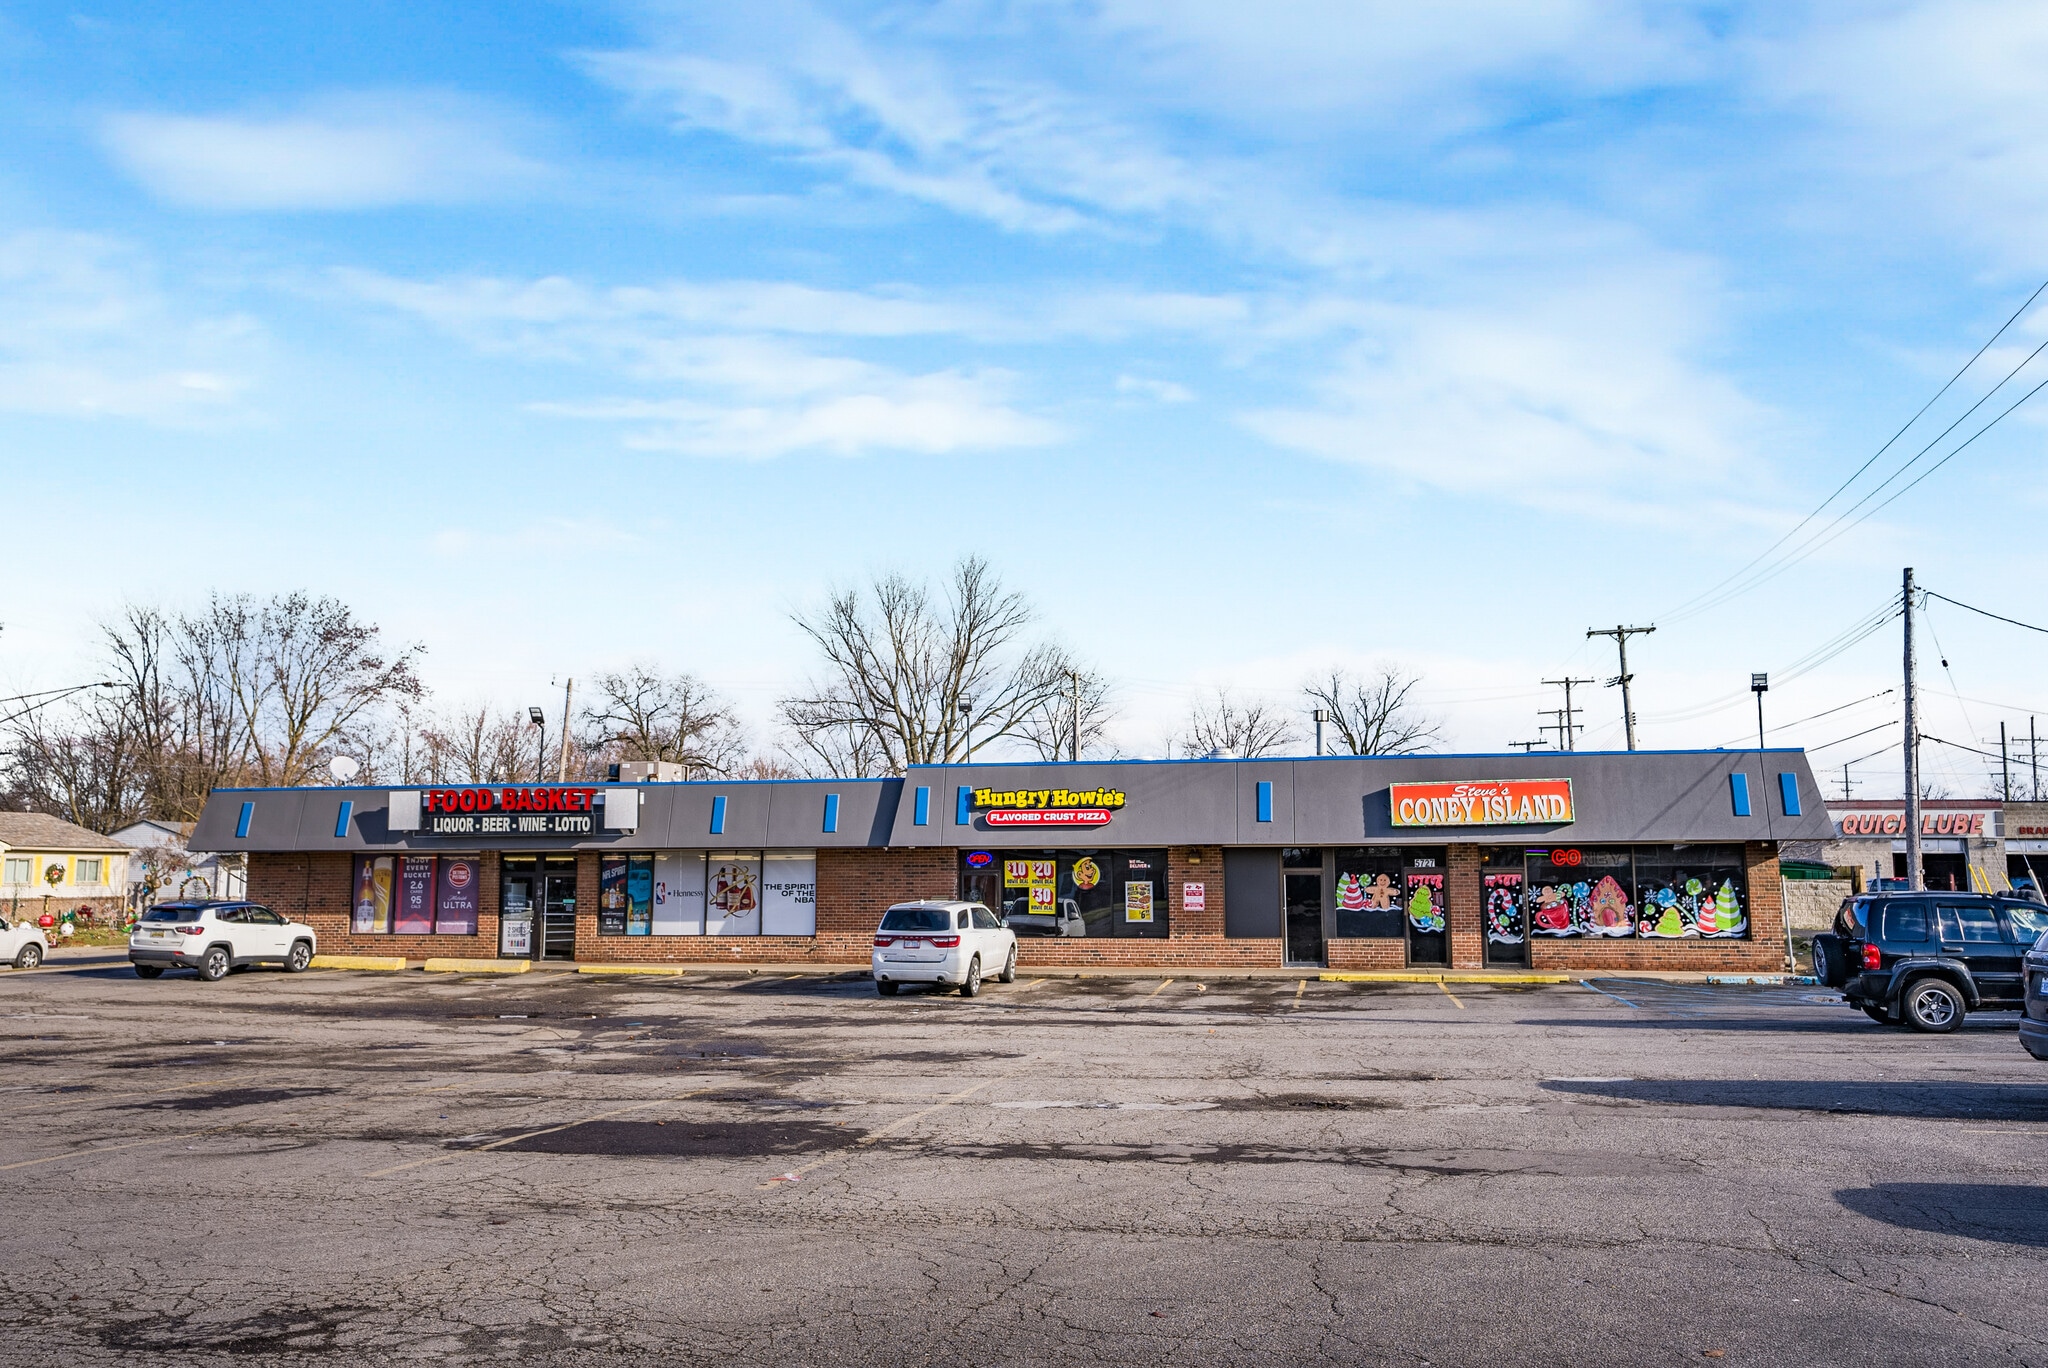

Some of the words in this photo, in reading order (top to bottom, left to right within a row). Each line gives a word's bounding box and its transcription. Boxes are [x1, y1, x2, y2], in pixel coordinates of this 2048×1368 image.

[974, 787, 1050, 809] Hungry
[1051, 787, 1126, 807] Howie's
[1452, 783, 1510, 798] Steve's
[428, 788, 495, 812] FOOD
[501, 787, 597, 811] BASKET
[1399, 796, 1476, 824] CONEY
[1482, 794, 1566, 822] ISLAND
[433, 817, 475, 833] LIQUOR
[482, 816, 511, 832] BEER
[518, 816, 547, 832] WINE
[555, 816, 591, 832] LOTTO
[990, 813, 1041, 822] FLAVORED
[1043, 813, 1076, 821] CRUST
[1077, 812, 1107, 821] PIZZA
[1922, 813, 1986, 835] LUBE
[969, 854, 990, 863] OPEN
[1414, 858, 1436, 868] 5727
[611, 865, 626, 877] SPIRIT
[1007, 861, 1026, 876] $10
[1032, 862, 1052, 877] $20
[410, 881, 423, 890] 2.6
[410, 896, 422, 904] 95
[673, 890, 704, 898] Hennessy
[1032, 888, 1051, 903] $30
